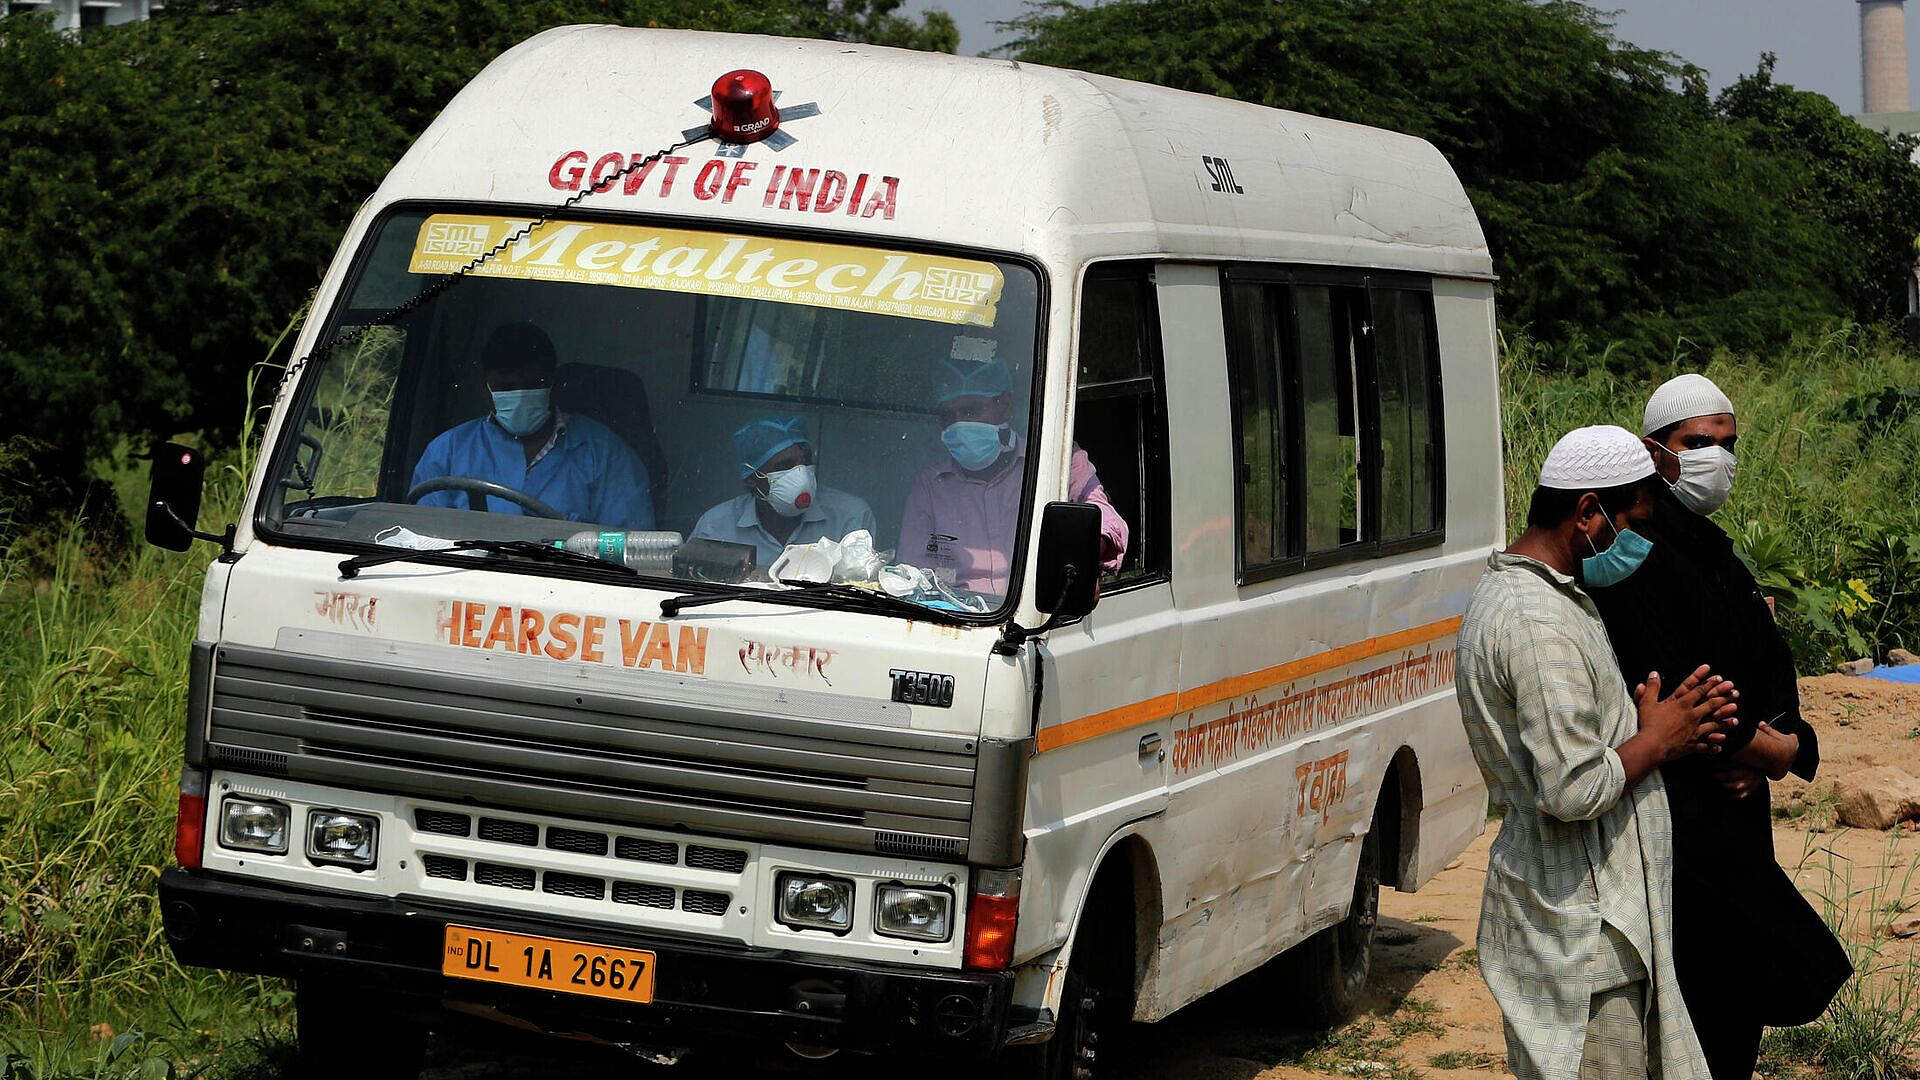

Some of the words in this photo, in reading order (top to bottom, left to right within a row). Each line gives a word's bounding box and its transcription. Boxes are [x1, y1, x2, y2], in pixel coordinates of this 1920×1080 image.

[741, 118, 770, 132] GRAND
[548, 150, 690, 198] GOVT
[693, 159, 758, 204] OF
[762, 164, 901, 221] INDIA
[1202, 155, 1244, 194] SML
[424, 240, 485, 256] ISUZU
[430, 224, 488, 241] SML
[489, 220, 924, 300] Metaltech
[928, 268, 994, 291] SML
[752, 286, 793, 300] DHALLUPURA
[914, 304, 946, 318] GURGAON
[436, 599, 607, 662] HEARSE
[618, 618, 709, 675] VAN
[889, 668, 955, 708] T3500
[446, 946, 464, 957] IND
[465, 938, 499, 973] DL
[523, 946, 553, 981] 1A
[570, 953, 646, 992] 2667
